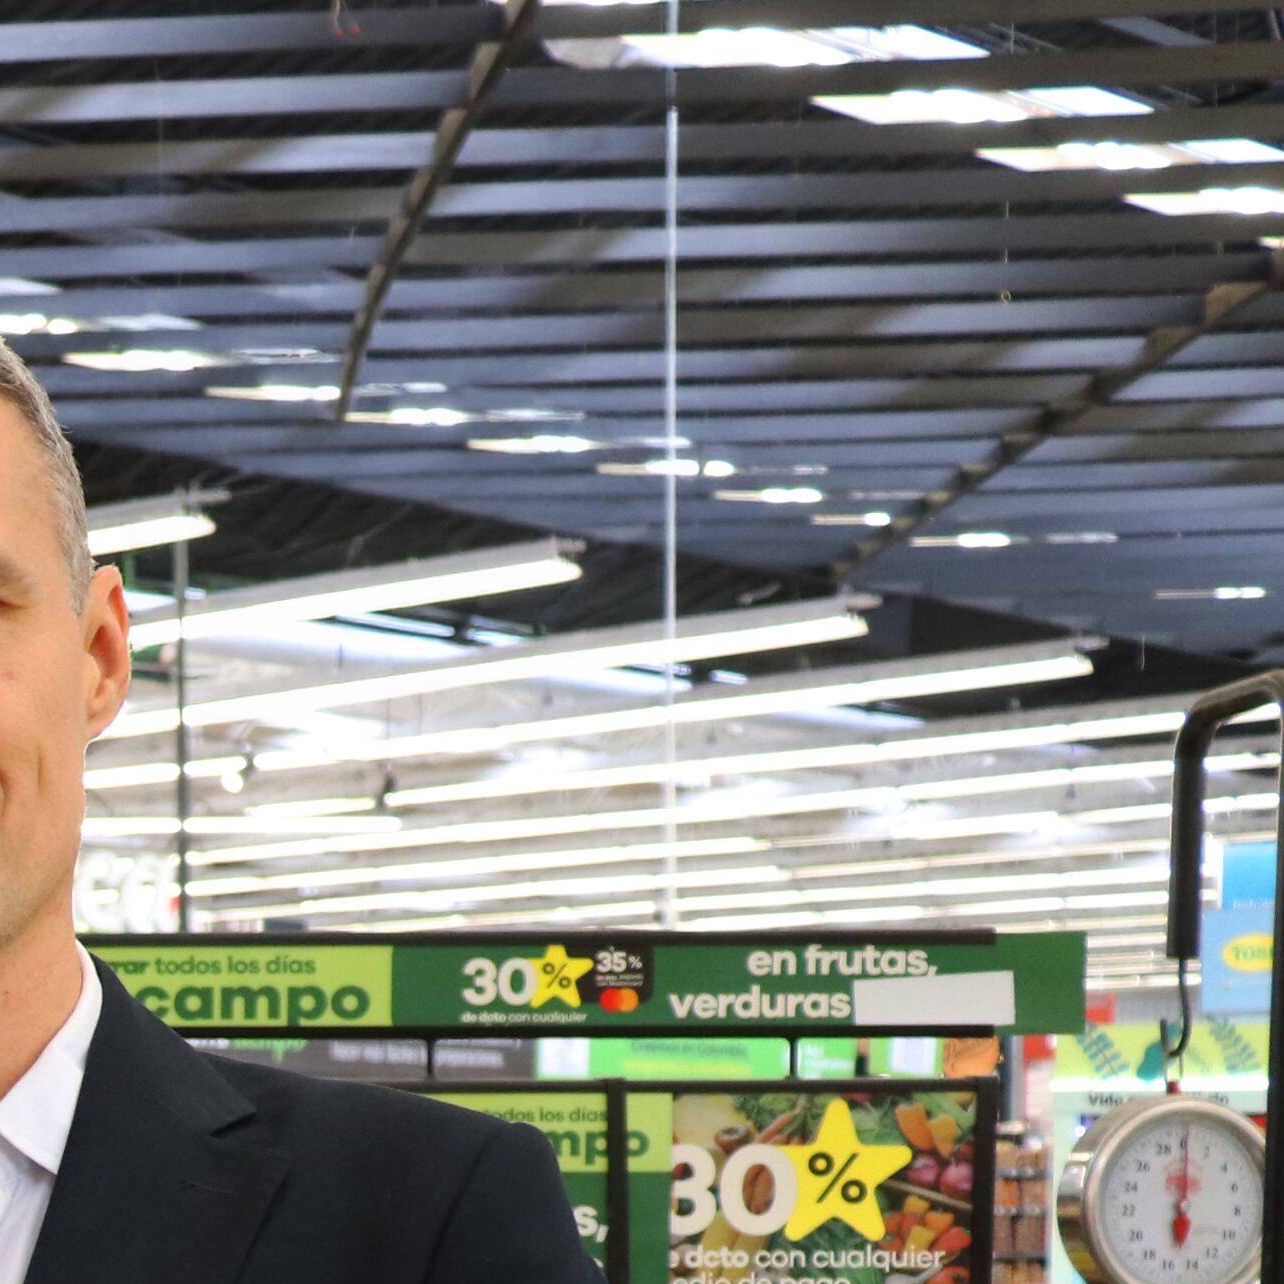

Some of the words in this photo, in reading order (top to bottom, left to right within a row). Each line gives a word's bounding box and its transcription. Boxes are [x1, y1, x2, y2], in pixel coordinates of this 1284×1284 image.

[154, 955, 223, 976] todos
[227, 955, 260, 976] los
[265, 955, 317, 976] días
[746, 949, 797, 976] en
[803, 944, 938, 977] frutas,
[134, 985, 372, 1027] campo
[669, 984, 852, 1020] verduras
[487, 1108, 536, 1123] odos
[540, 1106, 565, 1123] los
[545, 1129, 650, 1166] mpo
[685, 1245, 750, 1269] dcto
[755, 1249, 807, 1269] con
[812, 1245, 947, 1272] cualquier
